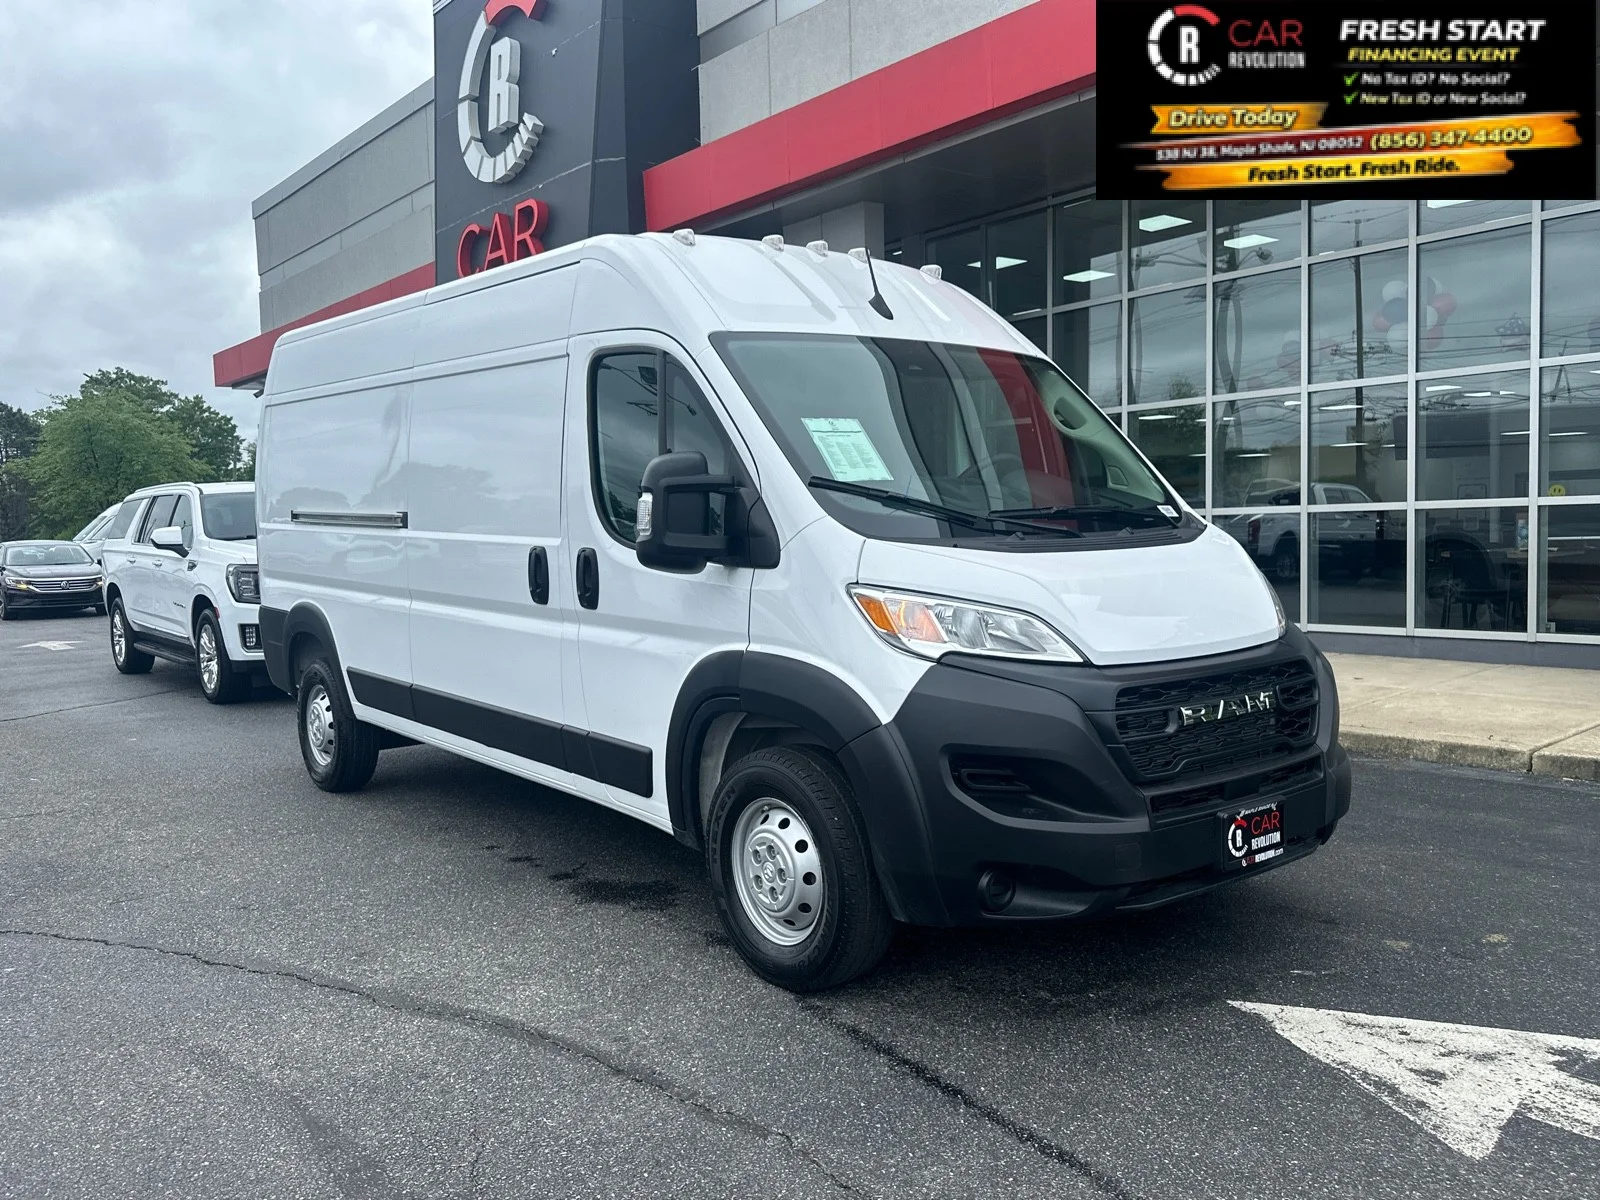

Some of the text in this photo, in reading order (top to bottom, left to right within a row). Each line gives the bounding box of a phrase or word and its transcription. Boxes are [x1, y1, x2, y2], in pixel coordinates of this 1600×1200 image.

[457, 198, 549, 279] CAR
[1251, 811, 1280, 835] CAR
[1251, 831, 1281, 850] REVOLUTION
